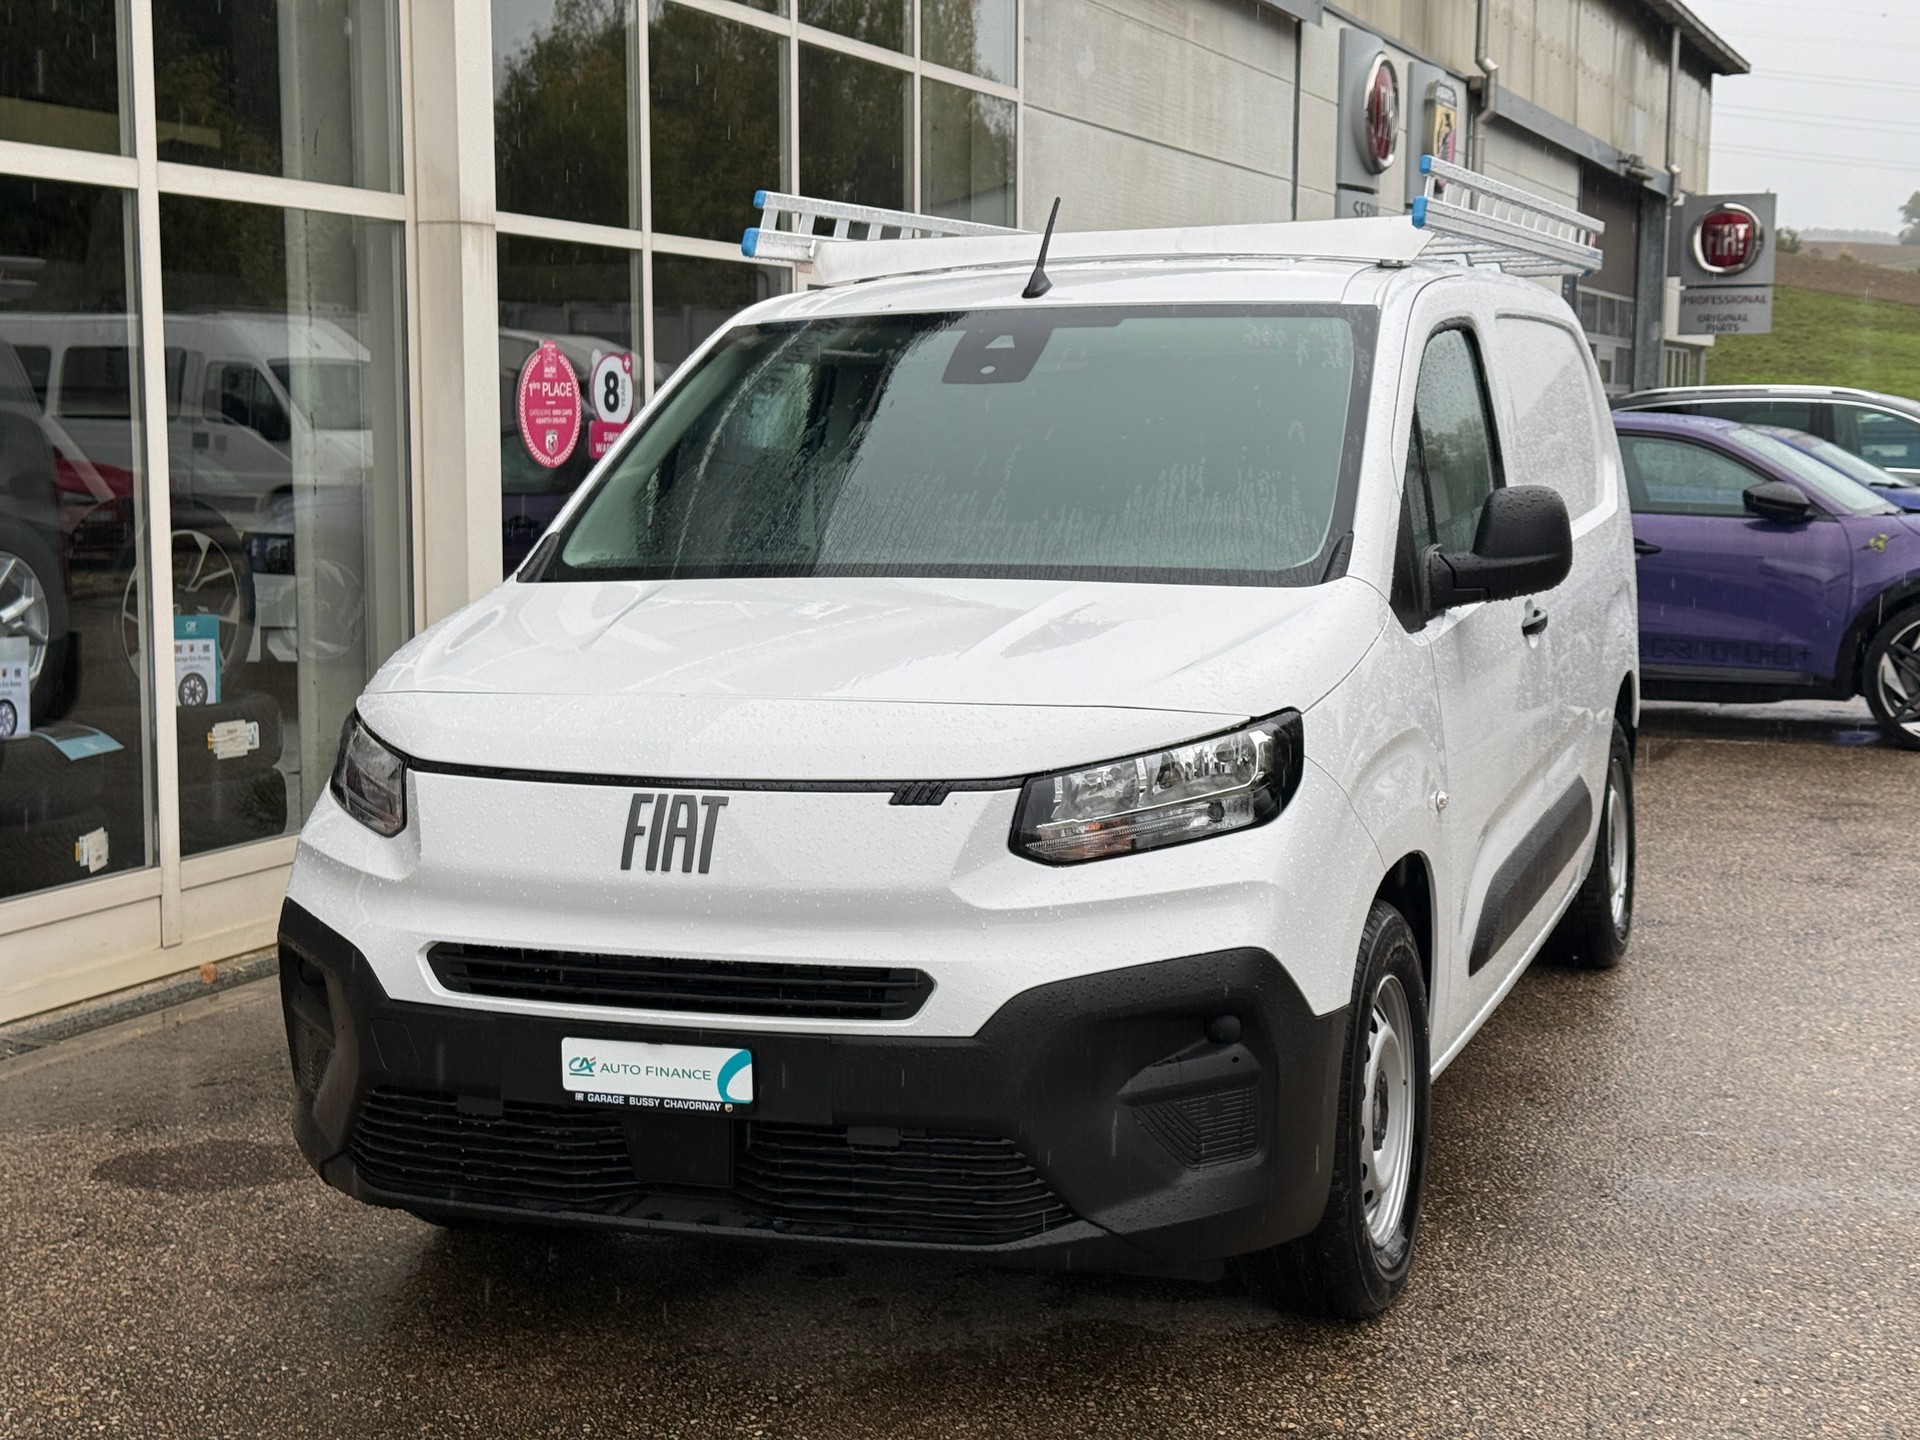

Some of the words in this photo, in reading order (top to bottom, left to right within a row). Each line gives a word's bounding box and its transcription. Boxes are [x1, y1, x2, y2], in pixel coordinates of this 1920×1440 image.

[1706, 223, 1750, 257] FIAT
[1682, 294, 1767, 305] PROFESSIONAL
[541, 381, 573, 398] PLACE
[604, 370, 620, 413] 8
[620, 792, 730, 875] FIAT
[599, 1061, 641, 1077] AUTO
[645, 1065, 712, 1081] FINANCE
[587, 1093, 625, 1105] GARAGE
[629, 1096, 661, 1108] BUSSY
[663, 1099, 722, 1113] CHAVORNAY
